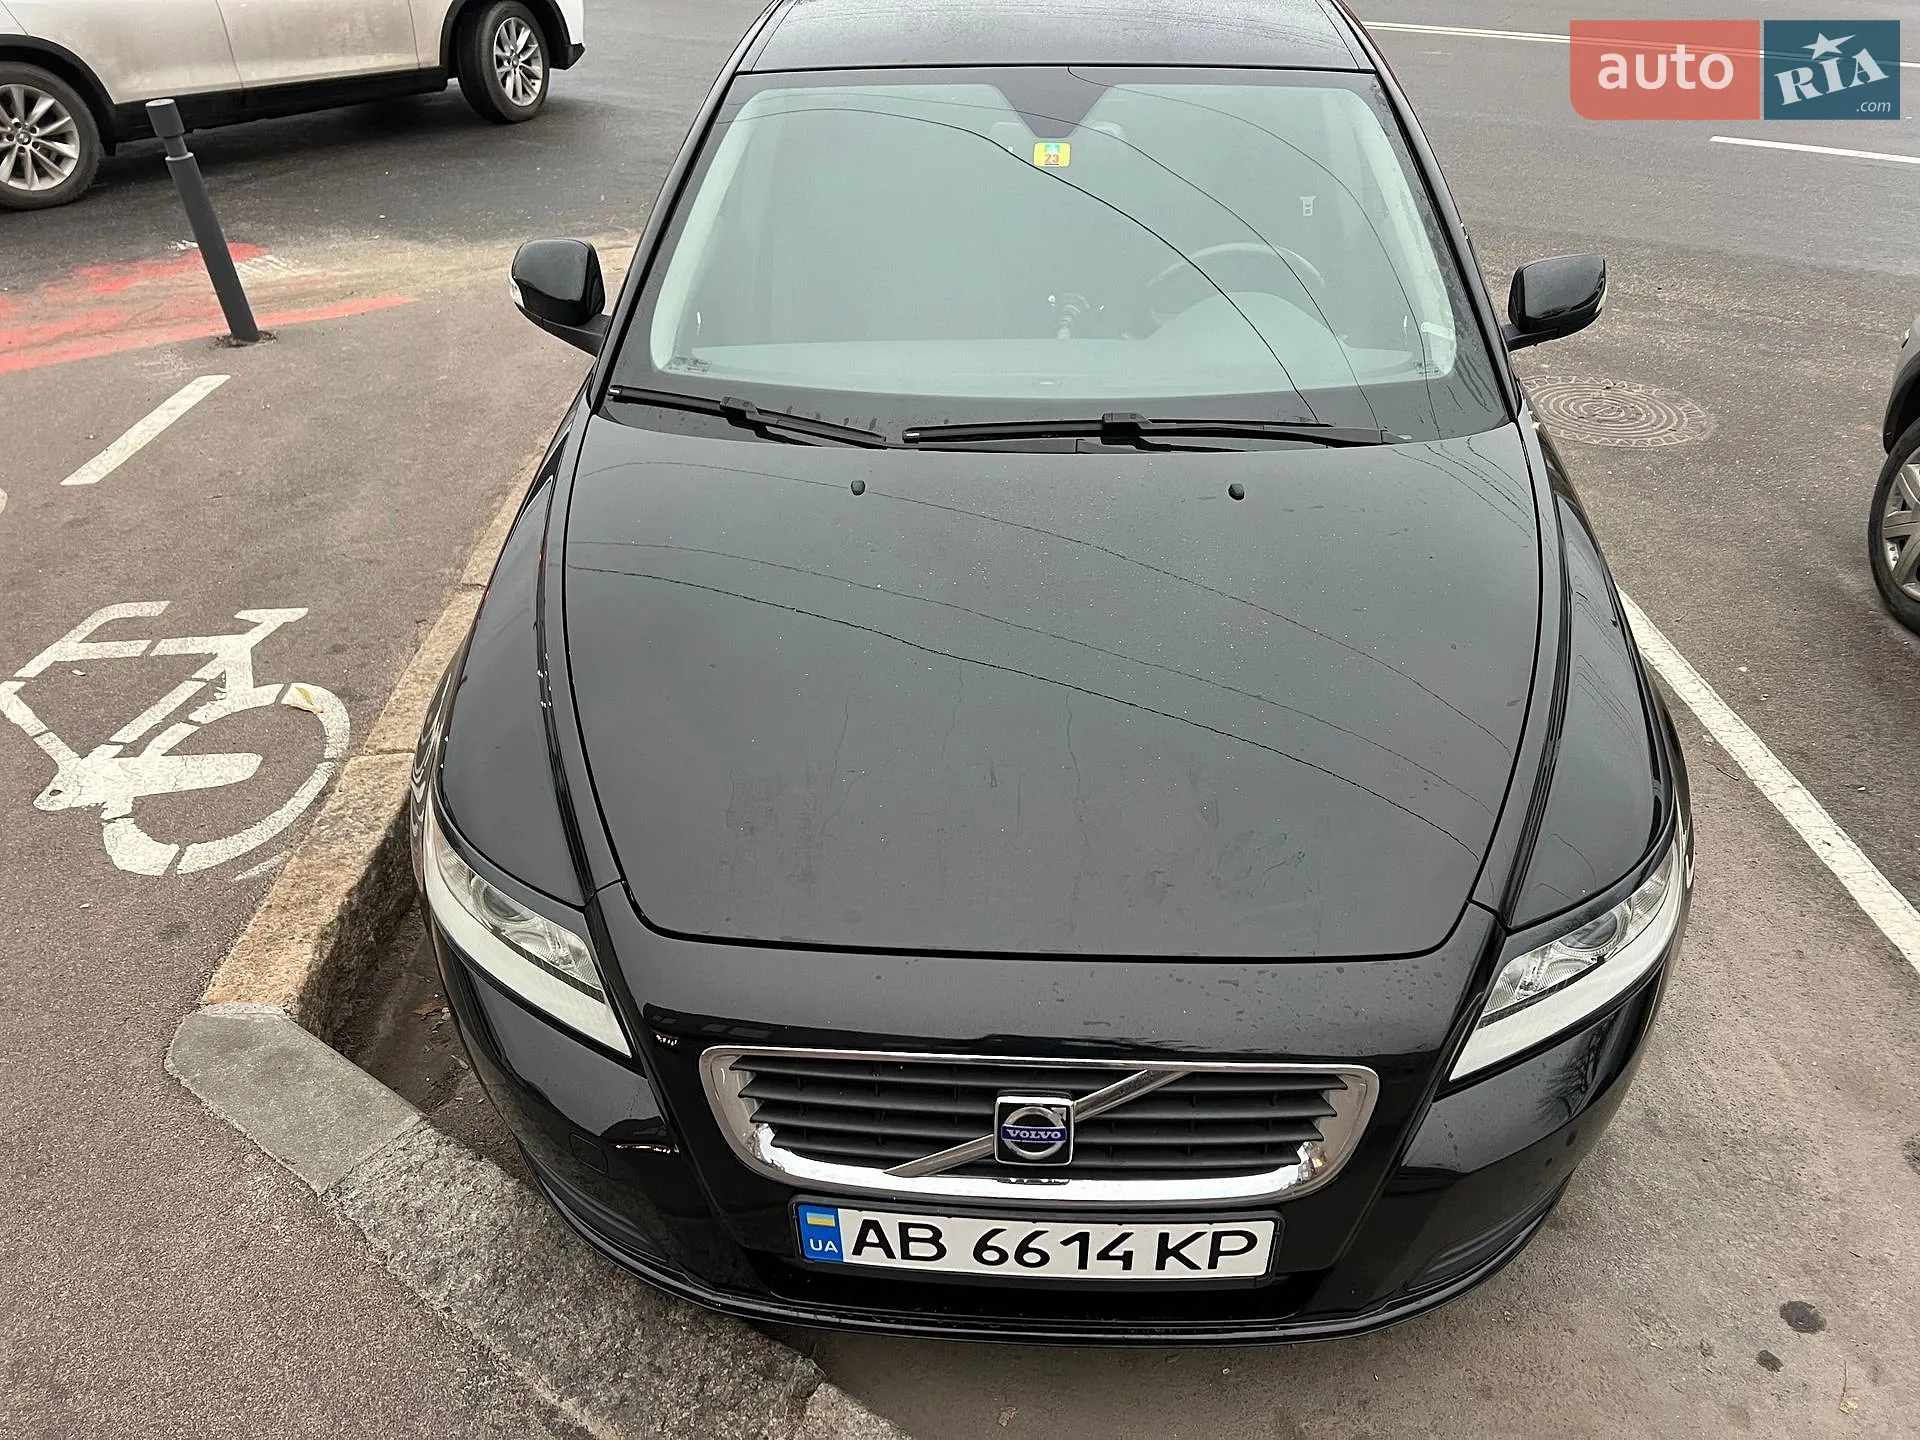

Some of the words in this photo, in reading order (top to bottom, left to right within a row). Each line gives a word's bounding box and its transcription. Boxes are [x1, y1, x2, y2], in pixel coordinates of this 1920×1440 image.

[1044, 153, 1060, 164] 23
[1006, 1128, 1062, 1139] VOLVO
[810, 1238, 839, 1254] UA
[851, 1219, 948, 1262] AB
[972, 1228, 1135, 1271] 6614
[1154, 1231, 1259, 1271] KP
